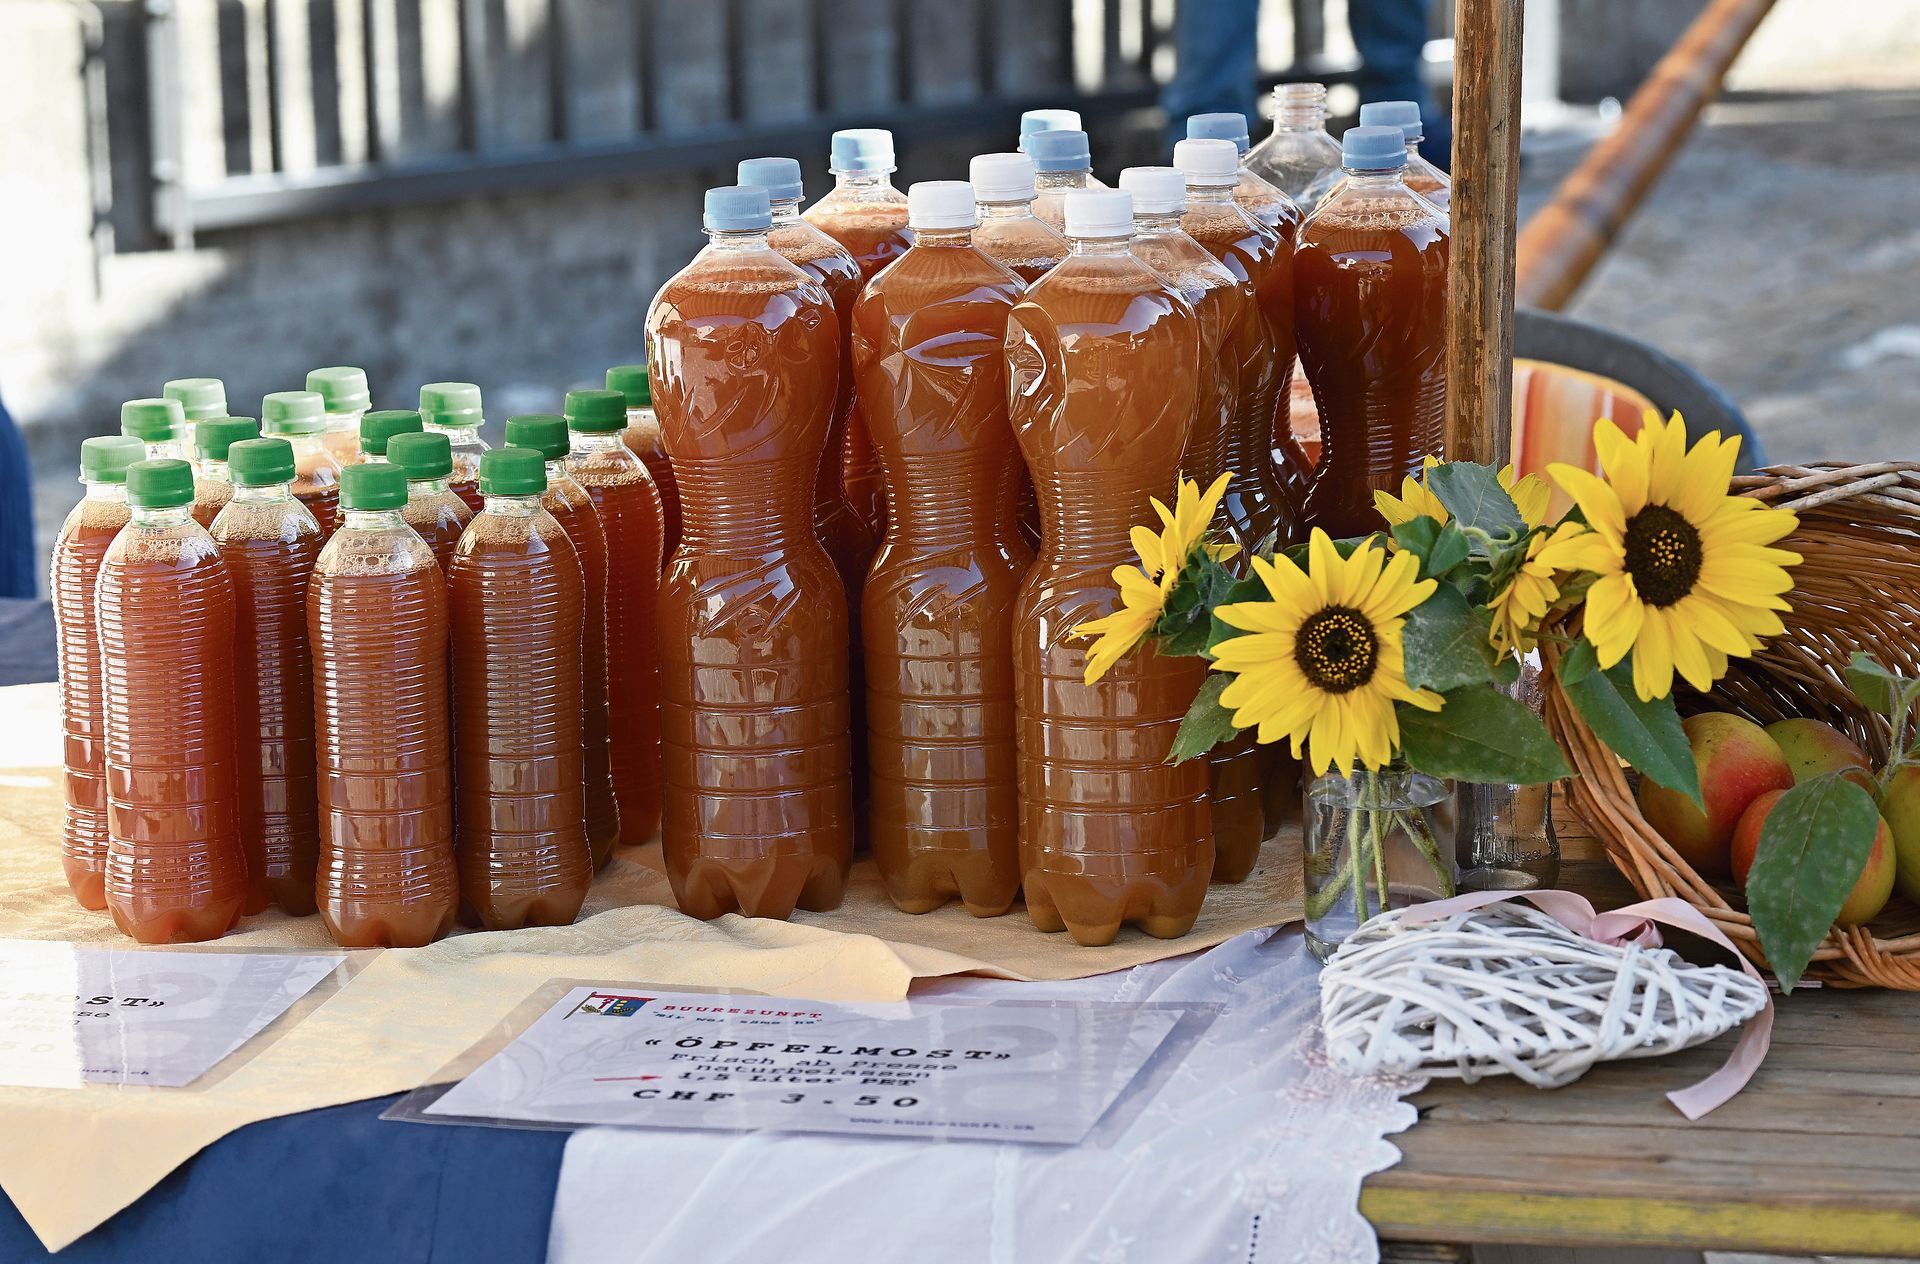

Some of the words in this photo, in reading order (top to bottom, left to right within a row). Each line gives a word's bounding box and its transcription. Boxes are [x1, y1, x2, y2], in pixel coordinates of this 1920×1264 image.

[662, 1005, 822, 1018] BUUREZUNFT
[645, 1036, 1011, 1061] «ÖPFELMOST»
[669, 1053, 775, 1066] Frisch
[796, 1059, 831, 1067] ab
[849, 1060, 958, 1070] Presse
[678, 1072, 731, 1081] 1,5
[748, 1075, 843, 1084] Liter
[860, 1078, 917, 1087] PET
[695, 1065, 931, 1079] naturbelassen
[632, 1089, 736, 1102] CHF
[779, 1093, 920, 1108] 3.50
